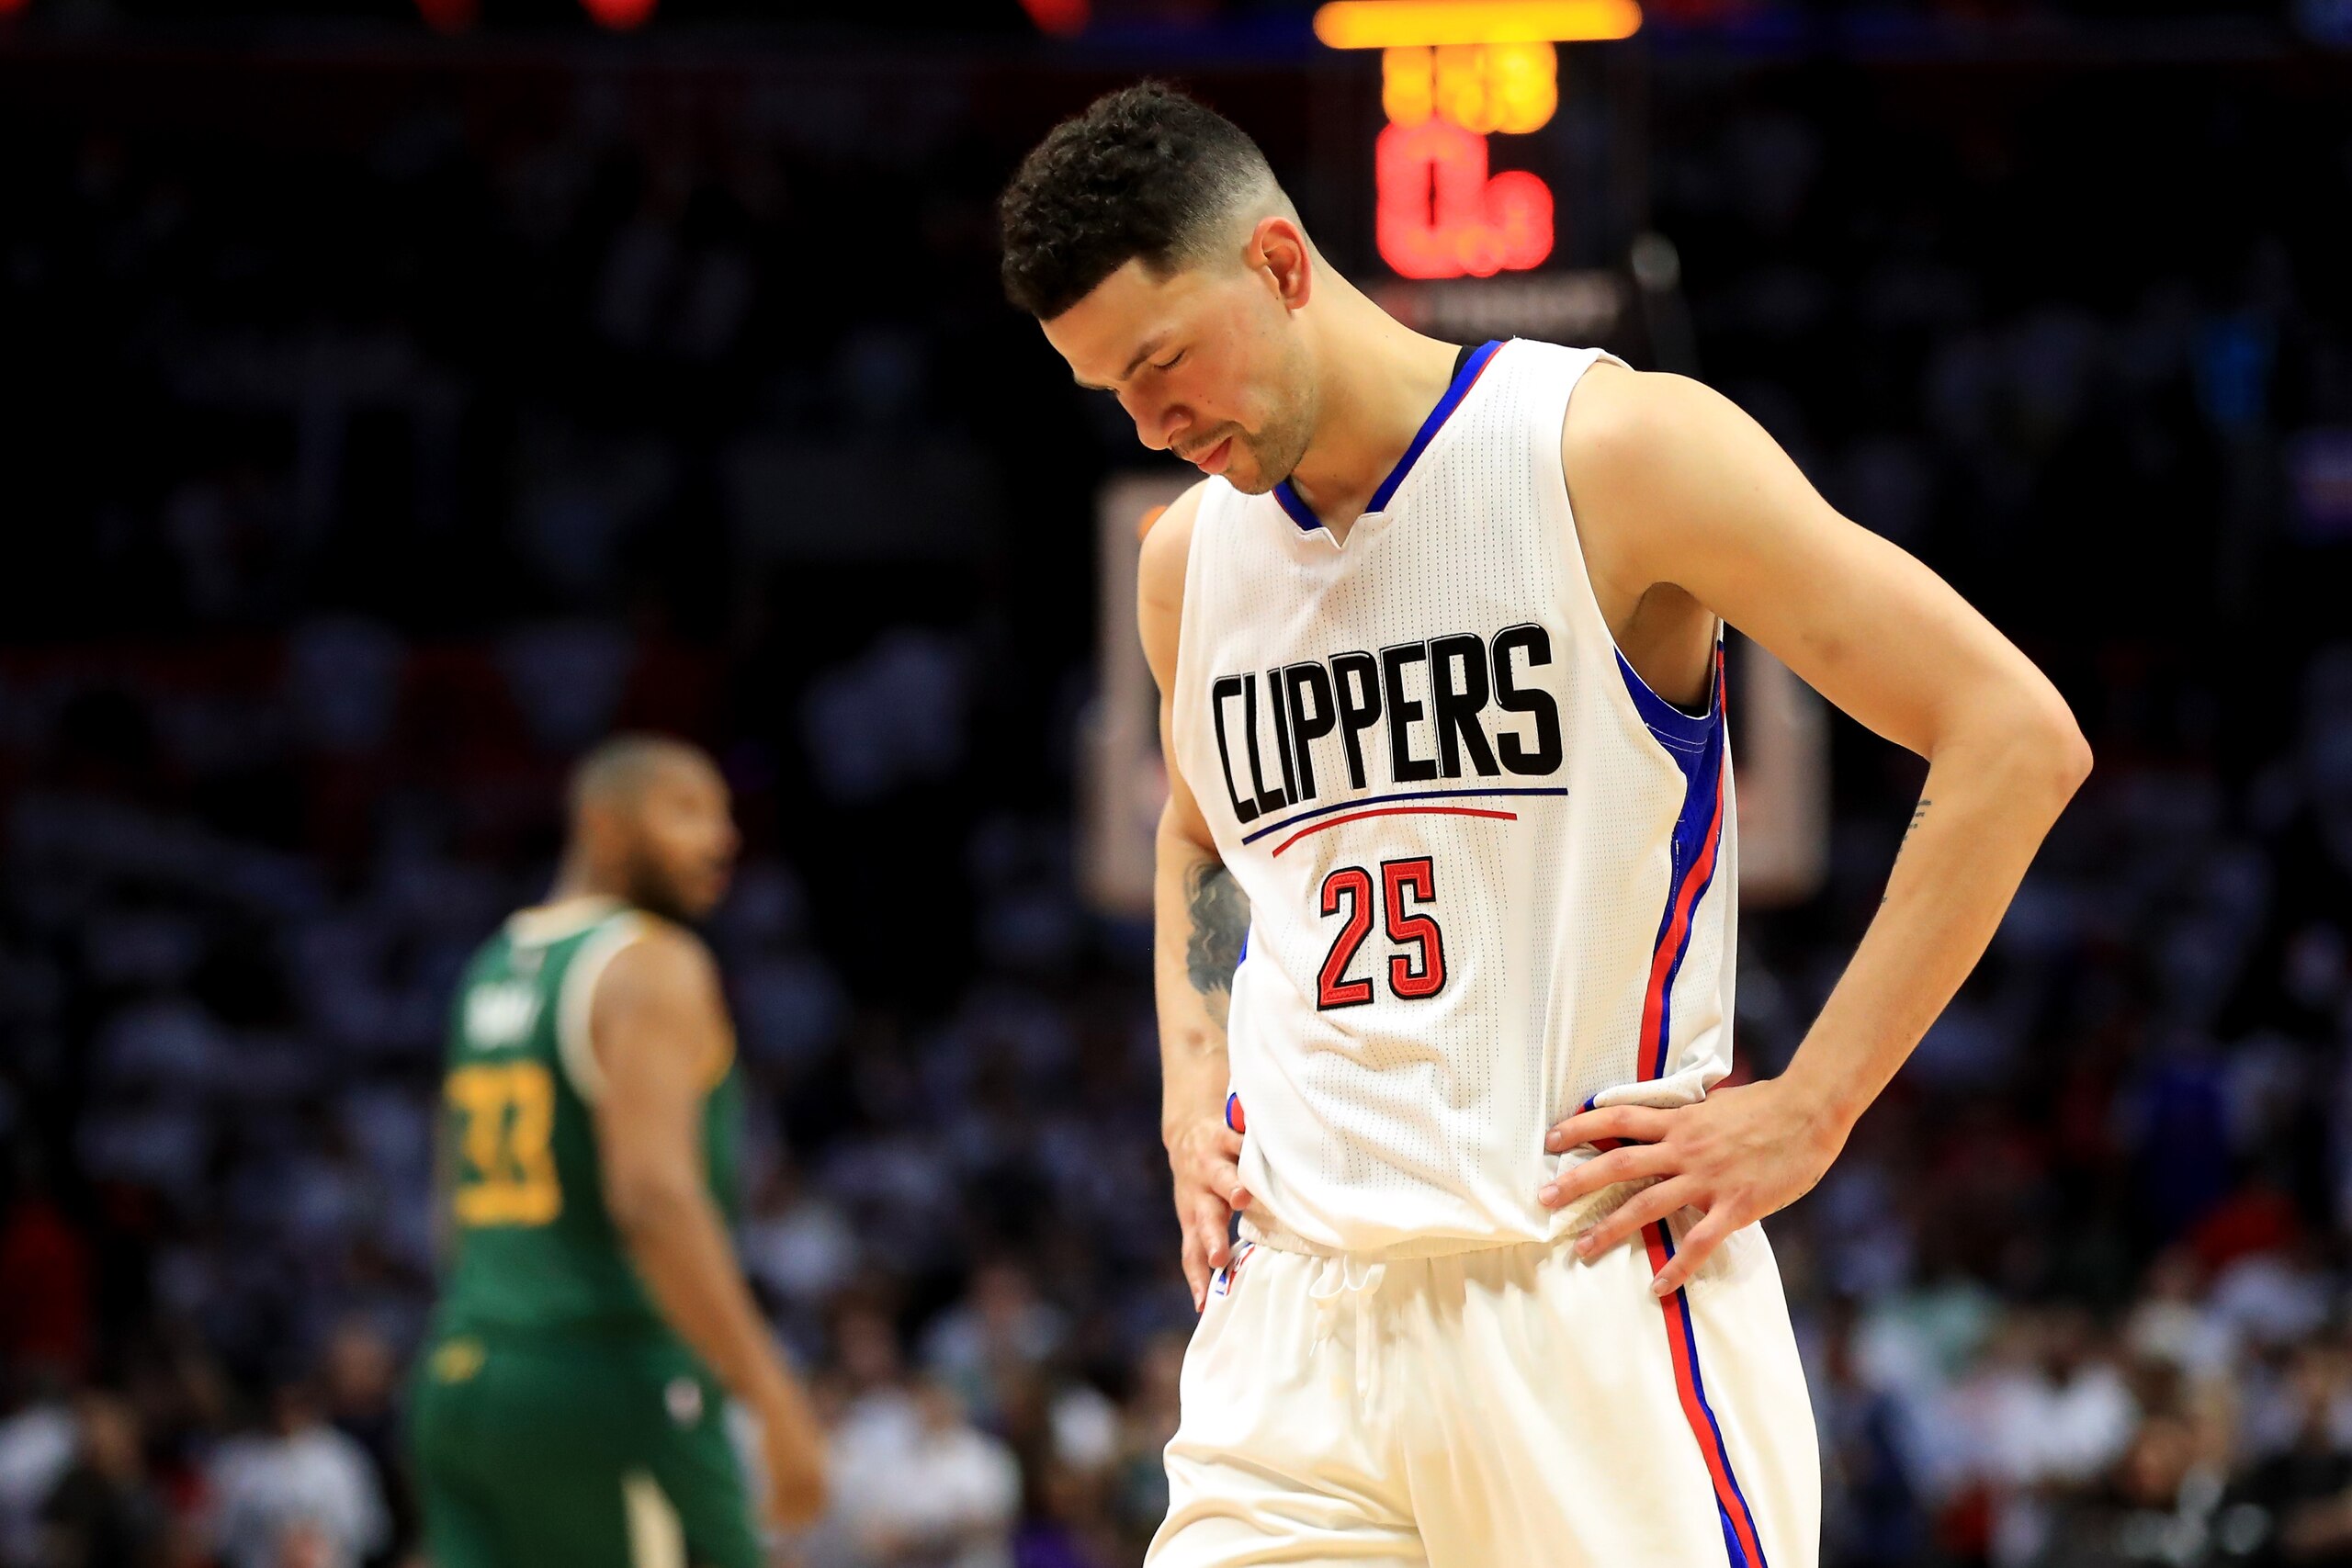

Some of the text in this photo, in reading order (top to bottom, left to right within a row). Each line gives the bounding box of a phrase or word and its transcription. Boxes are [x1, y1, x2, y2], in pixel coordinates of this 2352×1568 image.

[1212, 622, 1563, 824] CLIPPERS
[1317, 856, 1447, 1010] 25
[444, 1061, 561, 1227] 33
